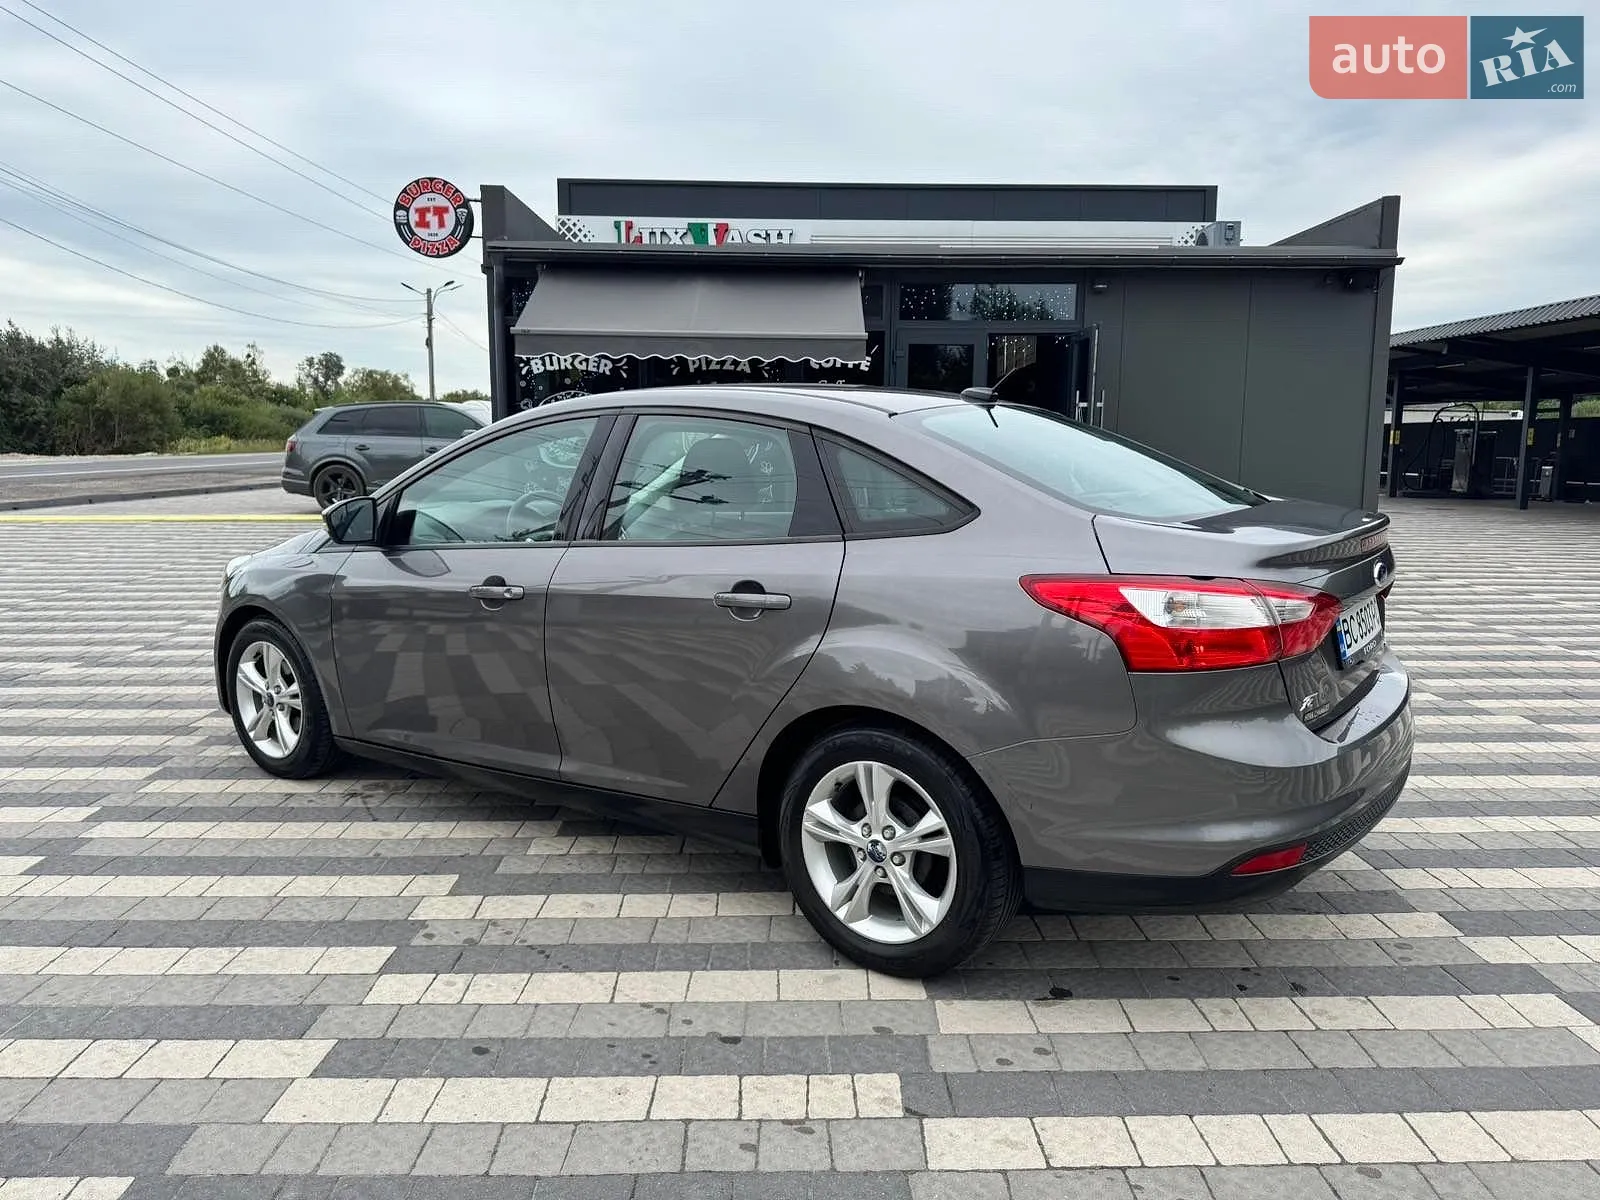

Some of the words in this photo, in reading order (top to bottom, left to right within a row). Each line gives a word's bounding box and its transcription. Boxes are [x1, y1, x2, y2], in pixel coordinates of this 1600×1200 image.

[399, 179, 464, 207] BURGER
[414, 206, 450, 229] IT
[409, 235, 460, 255] PIZZA
[530, 355, 613, 375] BURGER
[687, 356, 752, 373] PIZZA
